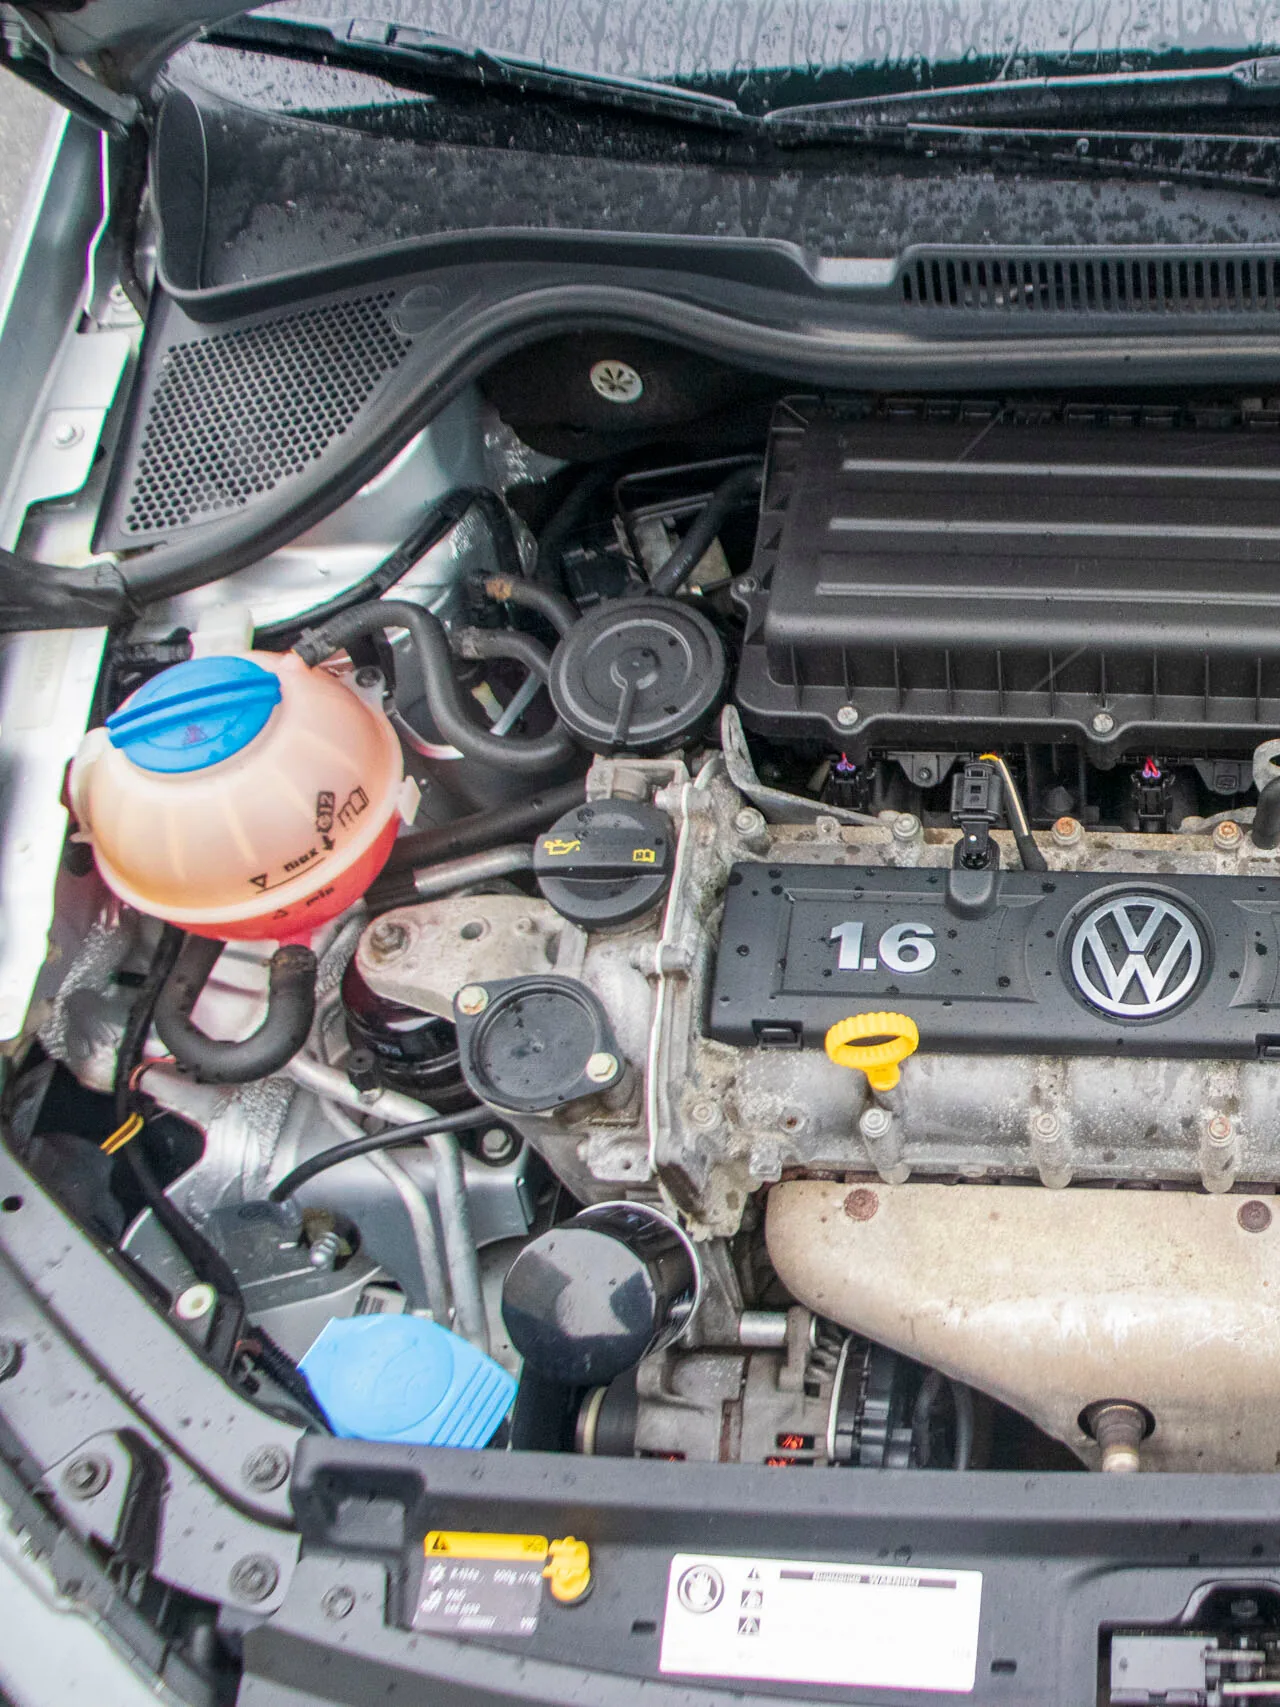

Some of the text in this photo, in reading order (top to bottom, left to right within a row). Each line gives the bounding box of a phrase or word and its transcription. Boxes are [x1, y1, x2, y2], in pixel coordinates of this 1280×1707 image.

[283, 847, 319, 872] max
[829, 921, 937, 973] 1.6
[1071, 895, 1203, 1018] VW
